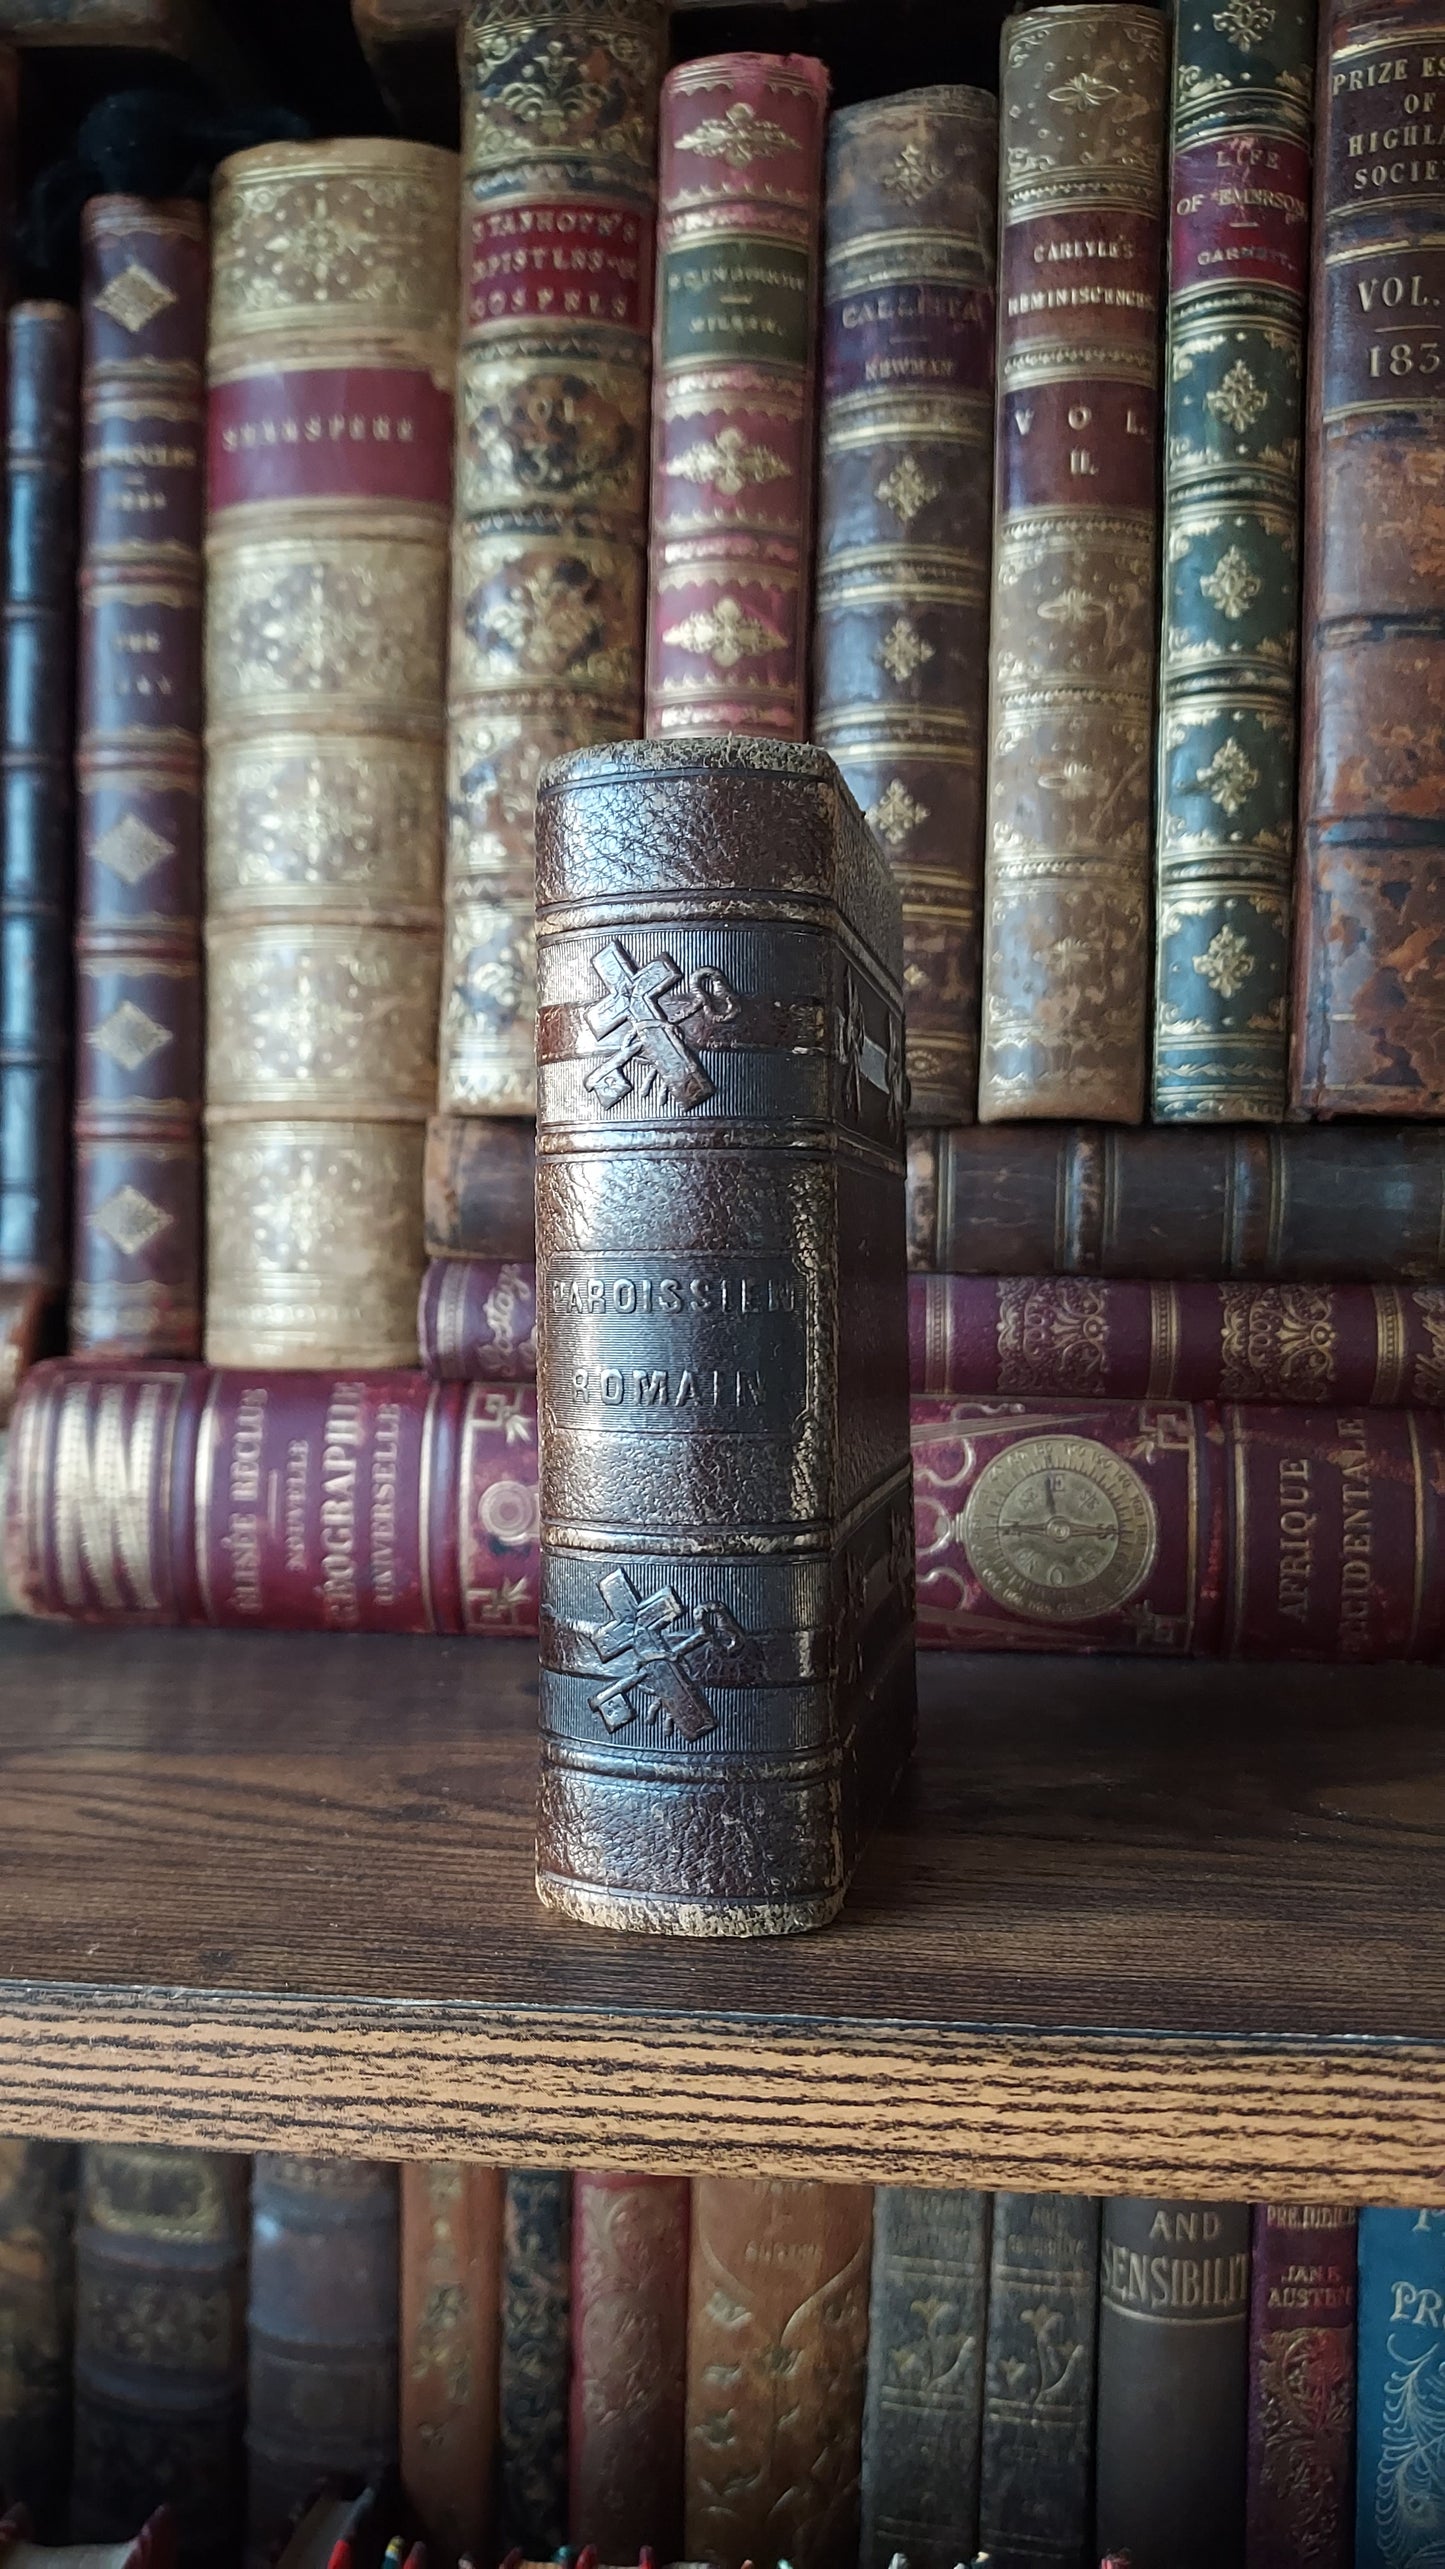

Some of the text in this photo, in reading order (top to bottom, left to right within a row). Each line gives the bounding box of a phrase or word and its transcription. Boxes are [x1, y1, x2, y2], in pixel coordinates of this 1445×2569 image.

[1332, 59, 1408, 96] PRIZE
[1404, 92, 1436, 114] OF
[1216, 149, 1279, 170] LIFE
[1354, 161, 1445, 189] SOCIE
[1177, 188, 1306, 218] OF EMERSON
[1034, 235, 1133, 263] CARLYLE'S
[1359, 275, 1440, 312] VOL.
[552, 1278, 795, 1315] PAROISSIEN
[571, 1369, 767, 1407] ROMAIN
[371, 1403, 401, 1606] UNIVERSELLE
[1278, 1458, 1317, 1623] AFRIQUE
[1149, 2210, 1222, 2242] AND
[1281, 2265, 1341, 2284] JANE
[1267, 2287, 1354, 2309] AUSTEN
[1389, 2280, 1445, 2329] PR
